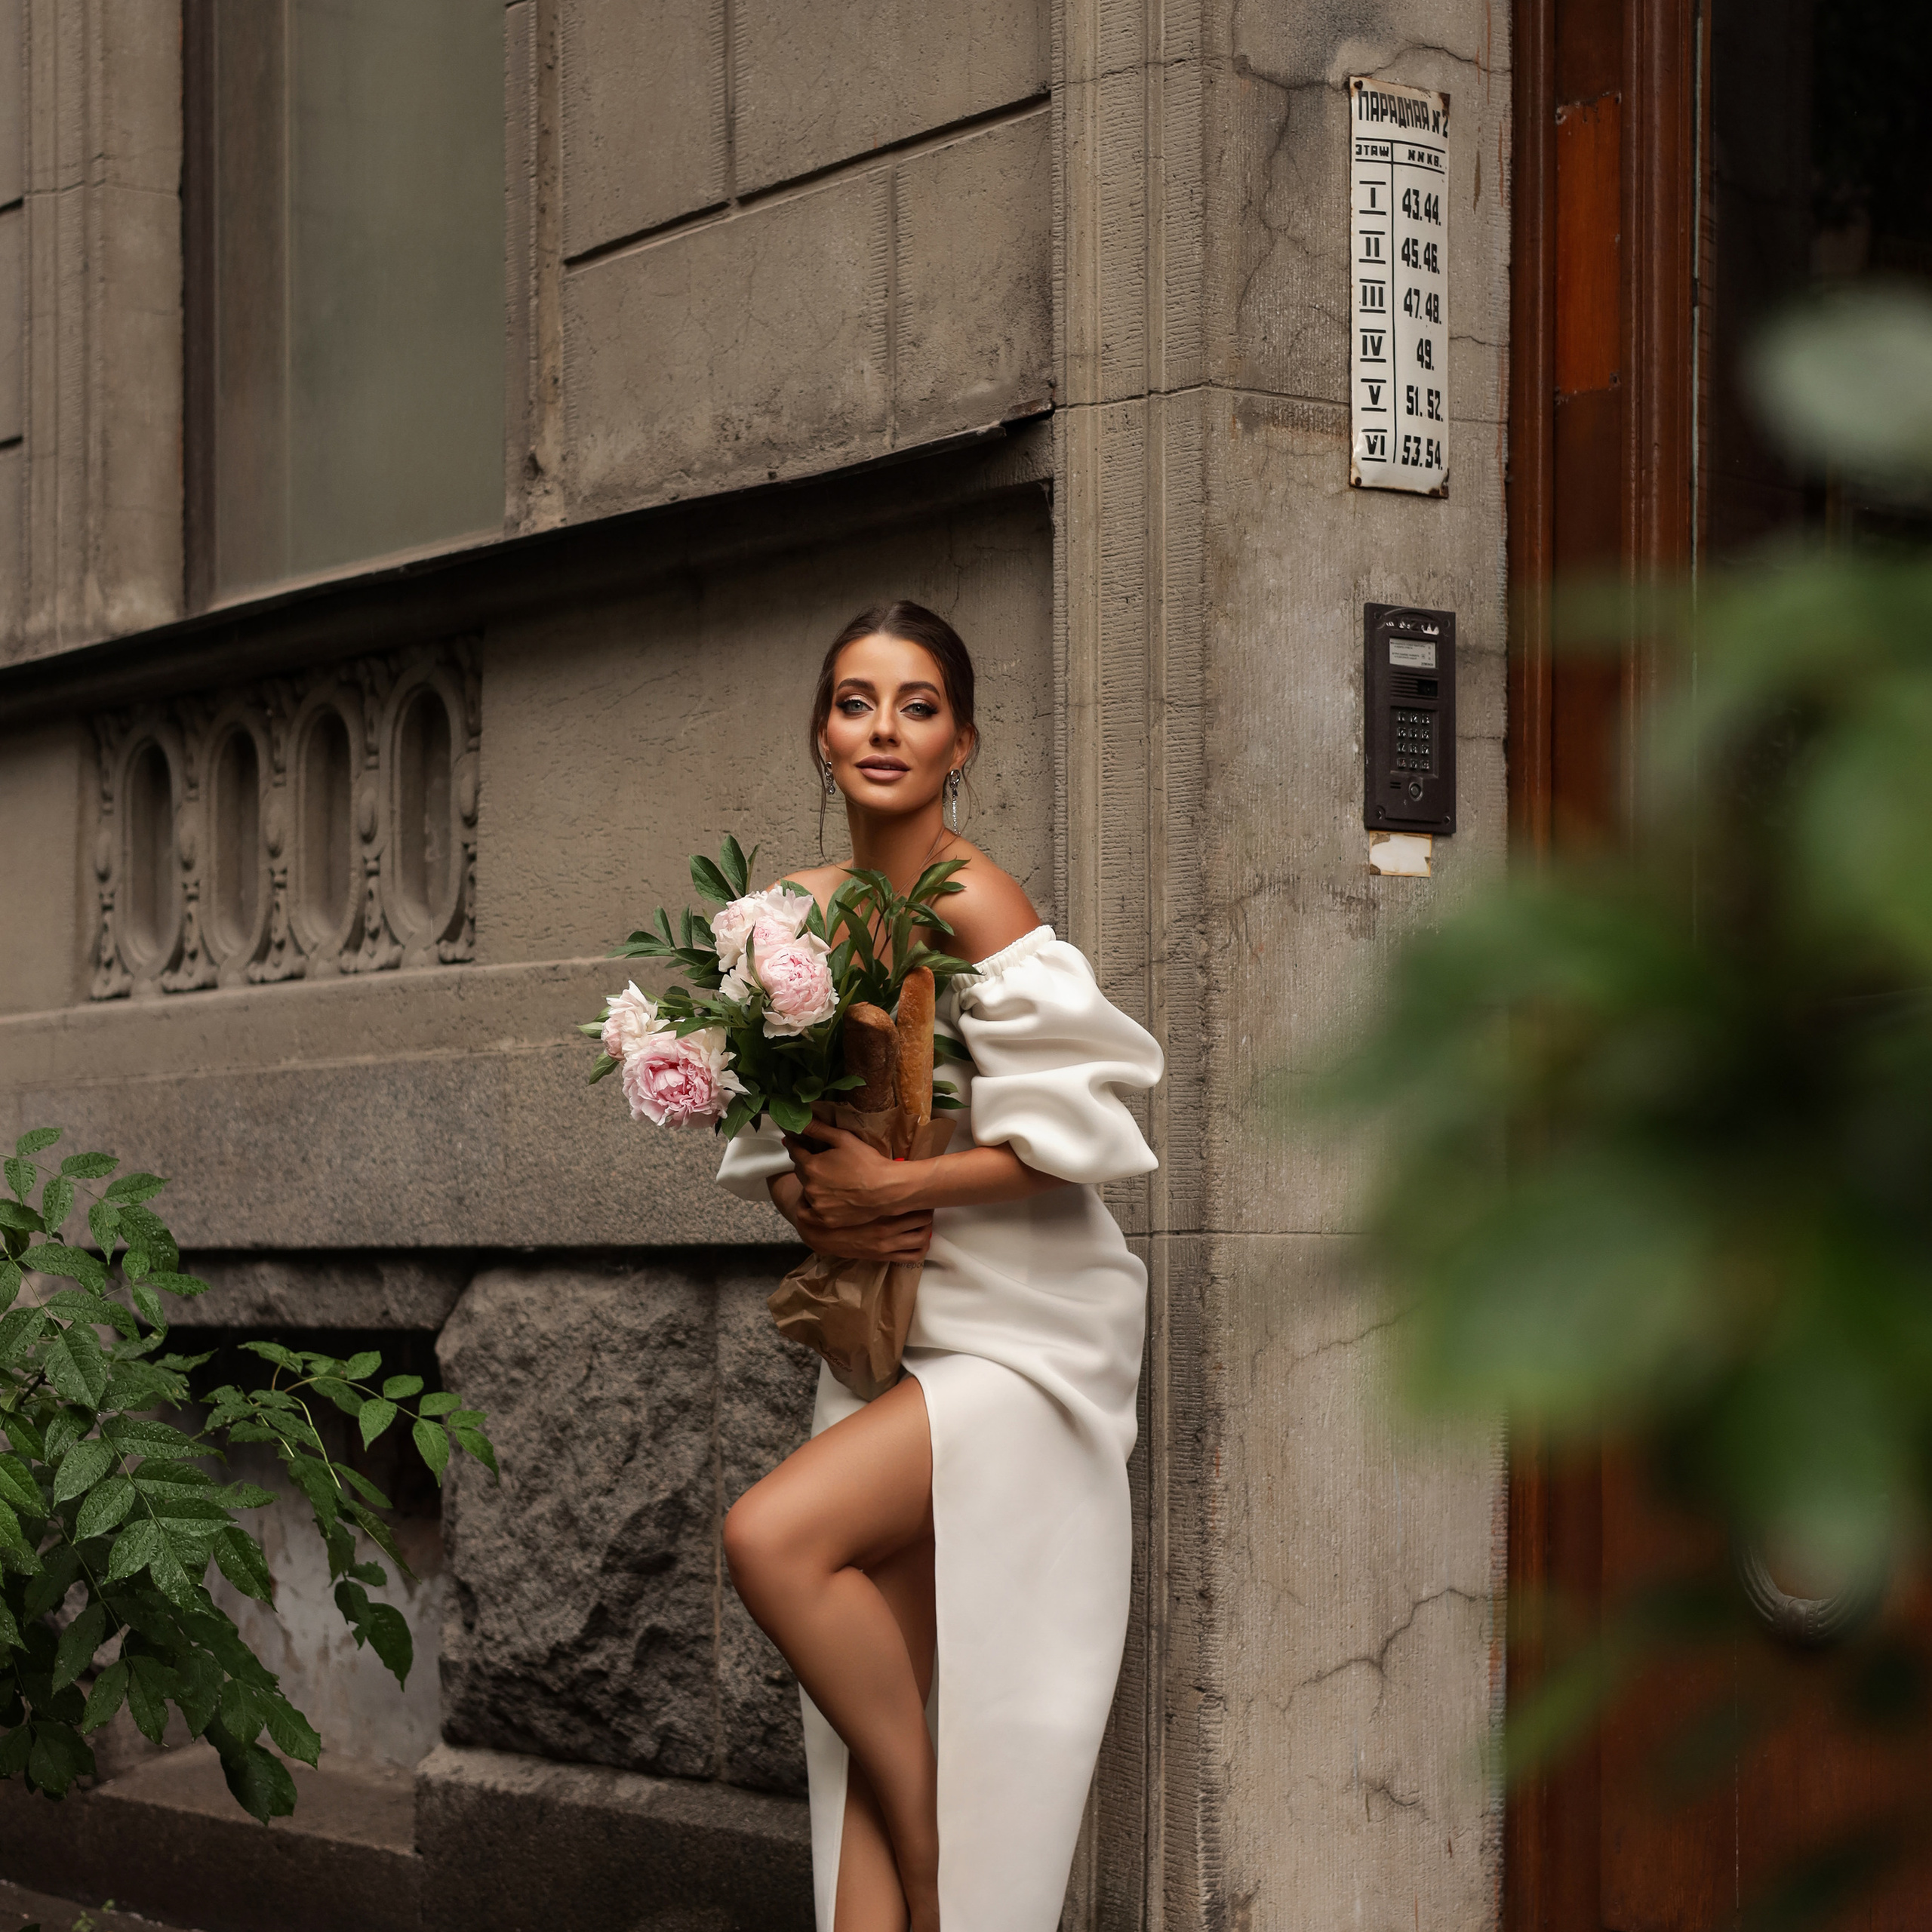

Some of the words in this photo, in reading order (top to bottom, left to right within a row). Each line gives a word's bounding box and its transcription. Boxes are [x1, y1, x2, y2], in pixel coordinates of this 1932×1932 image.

[1358, 91, 1429, 131] ПАРАДНАЯ
[1356, 144, 1389, 156] ЭТАЖ
[1363, 335, 1382, 355] IV
[1369, 386, 1380, 405] V
[1366, 435, 1385, 455] VI
